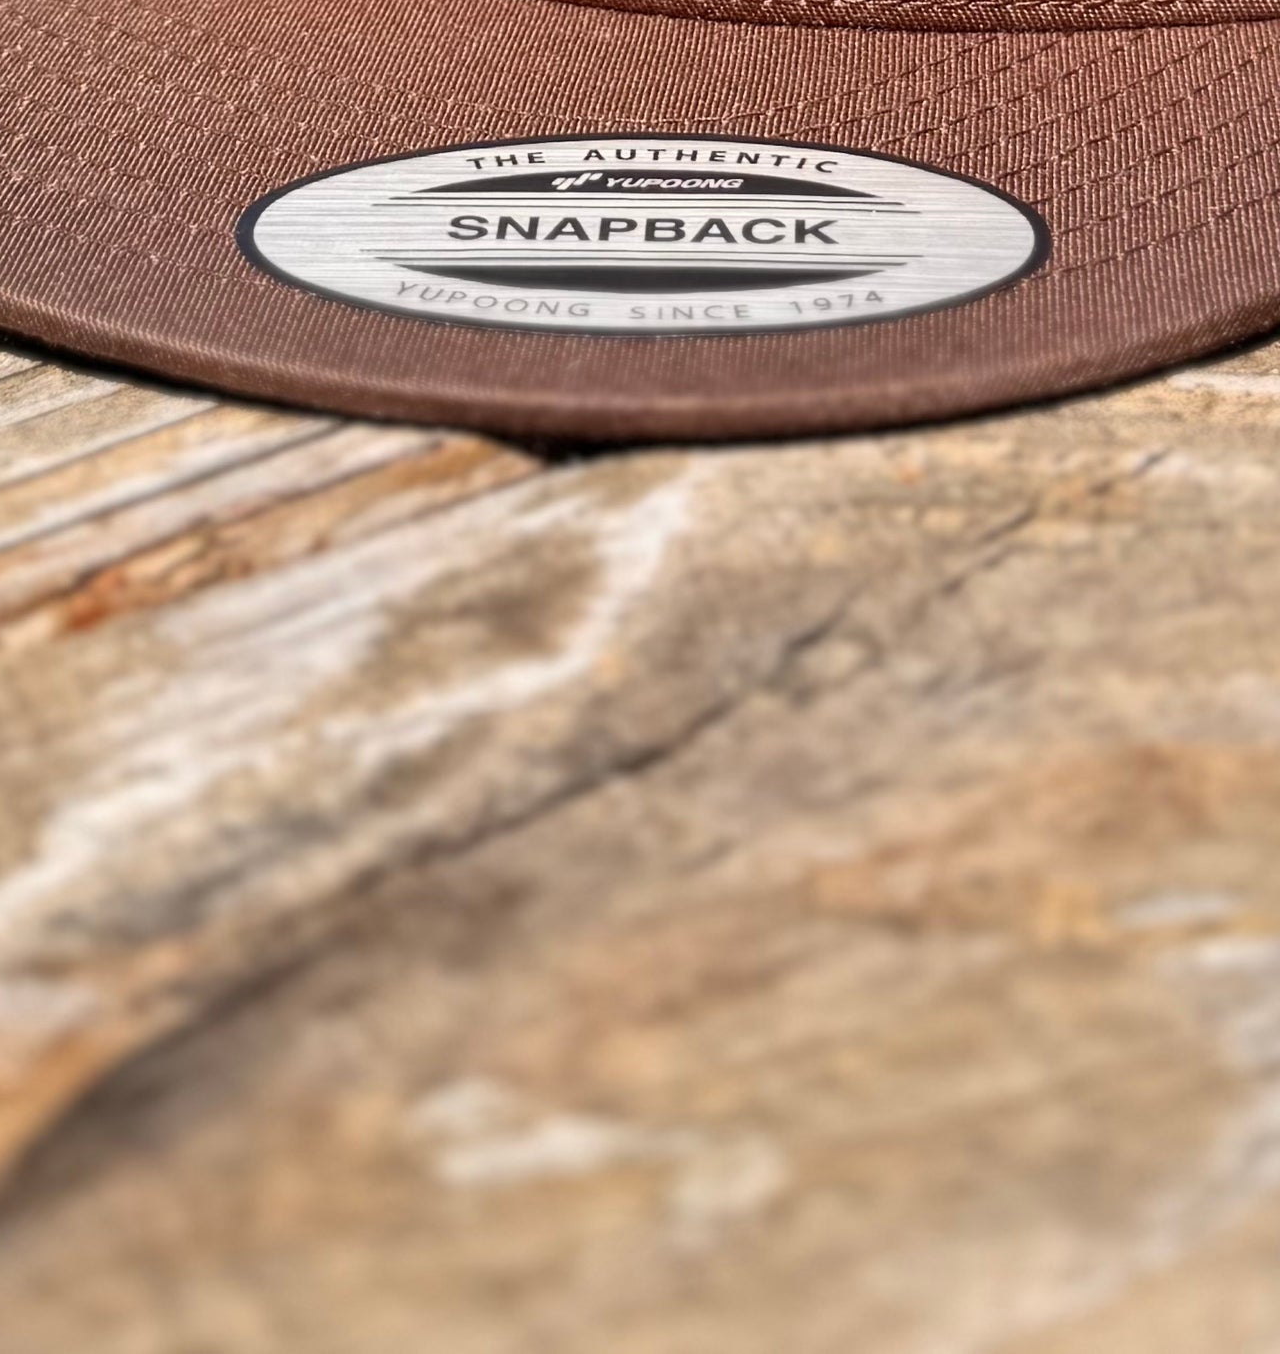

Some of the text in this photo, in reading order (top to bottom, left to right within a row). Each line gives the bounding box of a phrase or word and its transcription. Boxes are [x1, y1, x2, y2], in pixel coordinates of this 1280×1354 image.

[467, 148, 839, 174] THE AUTHENTIC
[605, 176, 744, 190] YUPOONG
[447, 215, 839, 245] SNAPBACK
[397, 281, 883, 320] YUPOONG SINCE 1974
